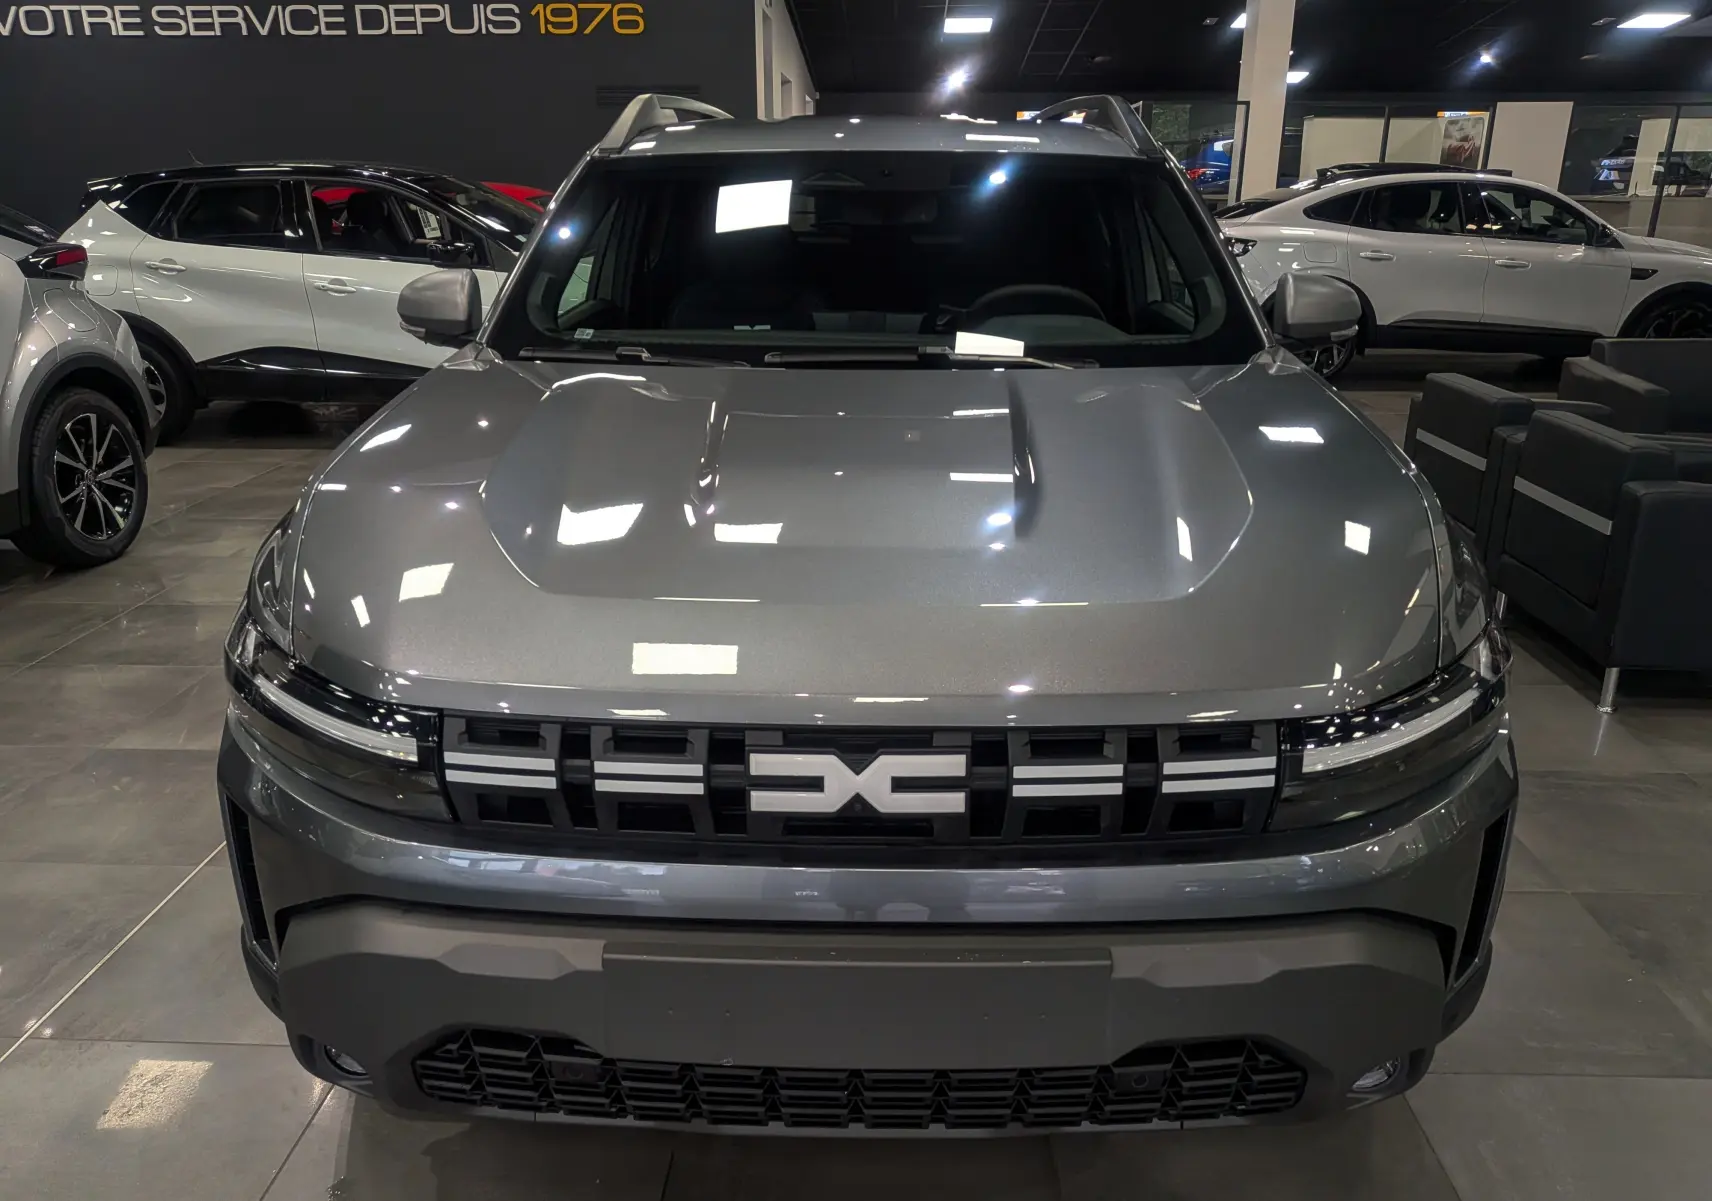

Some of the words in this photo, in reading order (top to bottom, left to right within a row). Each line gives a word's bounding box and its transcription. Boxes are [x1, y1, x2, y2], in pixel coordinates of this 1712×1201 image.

[151, 5, 347, 36] SERVICE
[354, 4, 521, 35] DEPUIS
[530, 3, 645, 35] 1976
